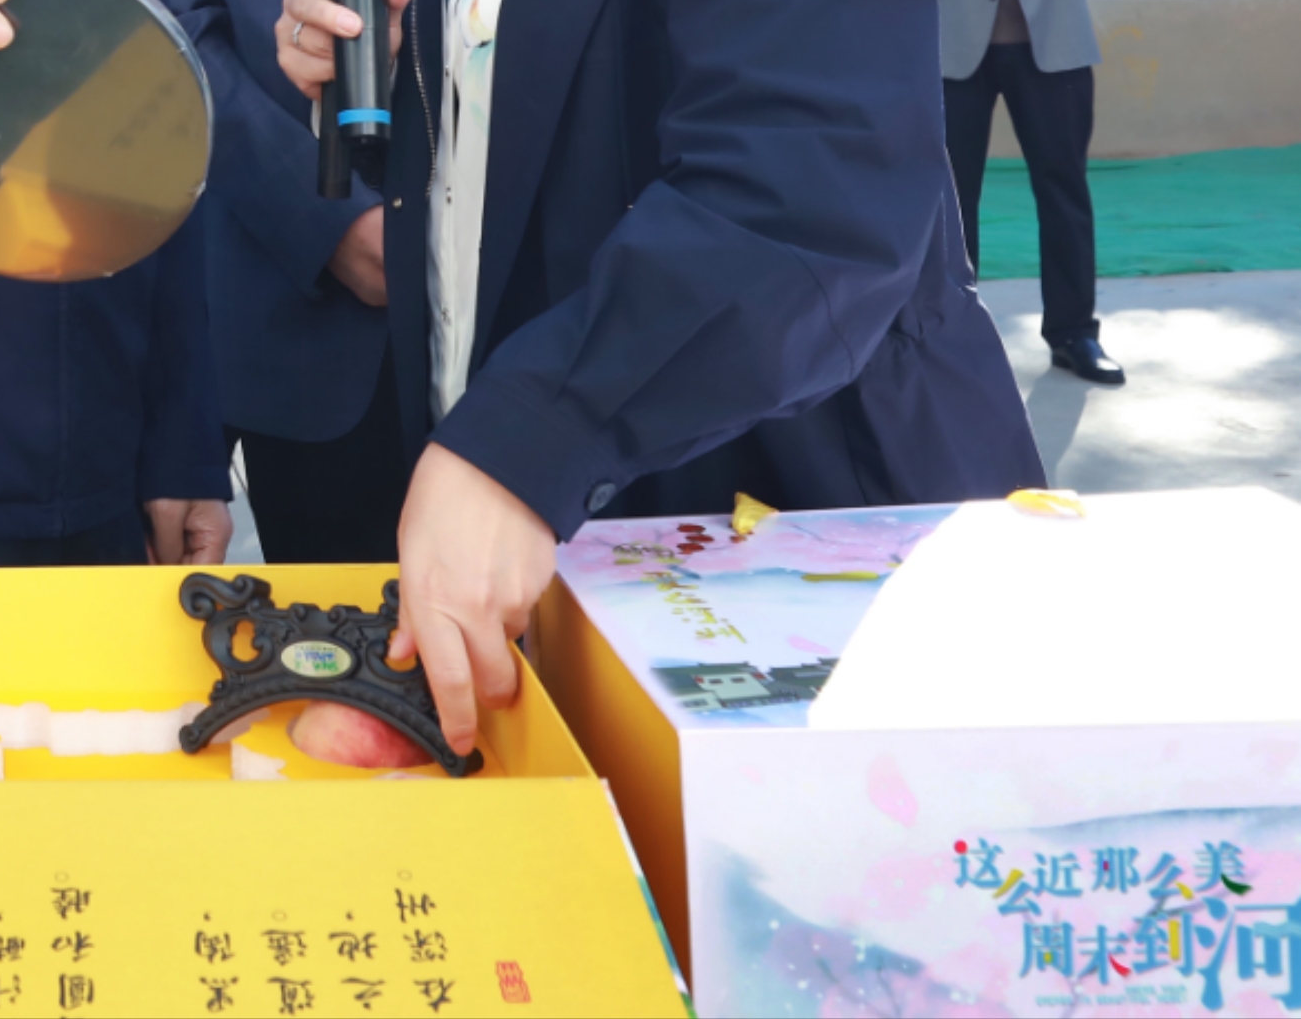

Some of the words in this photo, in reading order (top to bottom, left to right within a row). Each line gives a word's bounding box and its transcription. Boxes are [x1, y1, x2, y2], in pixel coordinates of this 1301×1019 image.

[953, 838, 1254, 916] 这么近那么美
[1018, 895, 1301, 1012] 周末到河
